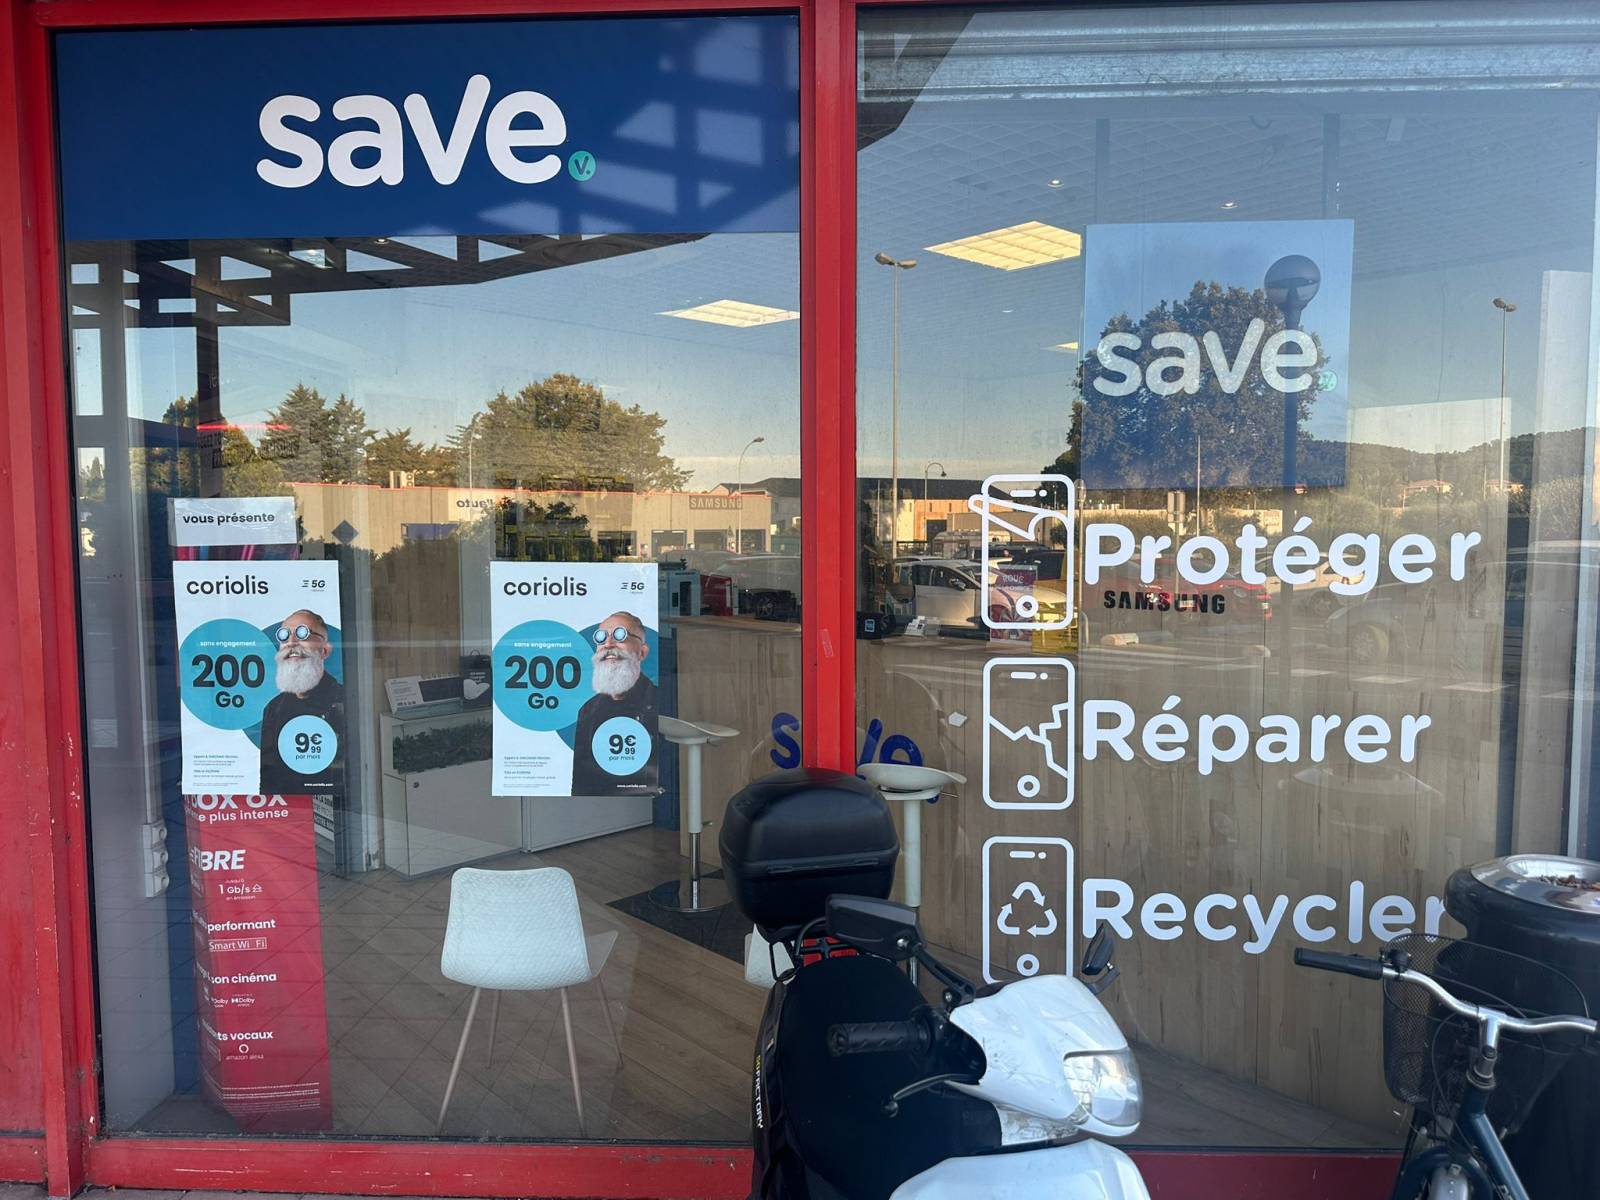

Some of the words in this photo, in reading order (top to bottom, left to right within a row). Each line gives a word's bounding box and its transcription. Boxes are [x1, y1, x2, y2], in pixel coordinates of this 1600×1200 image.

[256, 74, 567, 188] save
[1093, 317, 1318, 396] save
[690, 497, 742, 508] SAMSUNG
[183, 514, 214, 524] vous
[217, 512, 275, 526] présente
[1084, 516, 1482, 596] Protéger
[186, 575, 269, 595] coriolis
[311, 579, 326, 588] 5G
[503, 576, 588, 596] coriolis
[630, 582, 645, 591] 5G
[1103, 590, 1226, 614] SAMSUNG
[216, 640, 256, 648] engagement
[531, 641, 572, 649] engagement
[191, 654, 265, 688] 200
[504, 655, 582, 689] 200
[215, 690, 245, 708] Go
[527, 692, 559, 710] Go
[1082, 695, 1432, 776] Réparer
[209, 811, 237, 825] plus
[240, 808, 289, 820] intense
[226, 883, 251, 895] Gb/s
[1082, 878, 1447, 954] Recycler
[207, 919, 277, 934] performant
[208, 941, 236, 951] Smart
[231, 972, 277, 983] cinéma
[230, 1030, 274, 1041] vocaux
